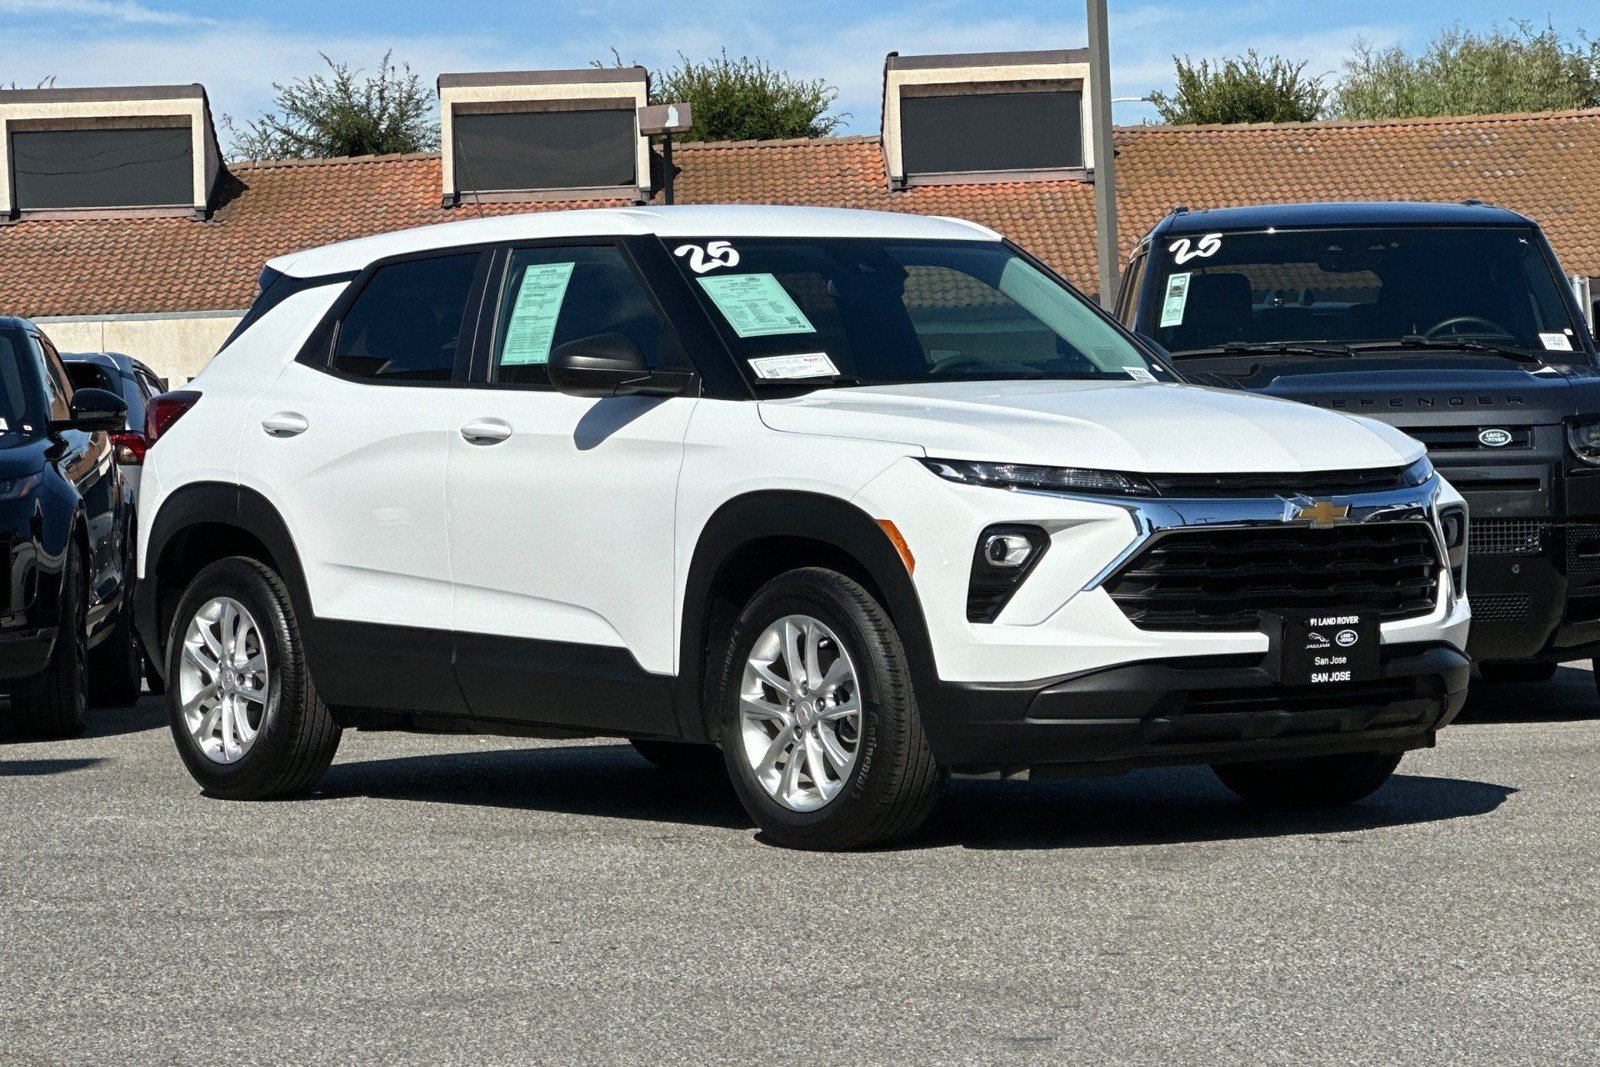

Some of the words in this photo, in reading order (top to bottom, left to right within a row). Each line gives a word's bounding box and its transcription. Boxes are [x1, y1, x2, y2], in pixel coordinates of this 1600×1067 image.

[1168, 232, 1223, 265] 25
[673, 240, 740, 274] 25
[1318, 617, 1336, 626] LAND
[1337, 615, 1359, 625] ROVER
[1314, 656, 1329, 666] San
[1329, 655, 1347, 665] Jose
[1311, 672, 1329, 683] SAN
[1329, 671, 1351, 682] JOSE
